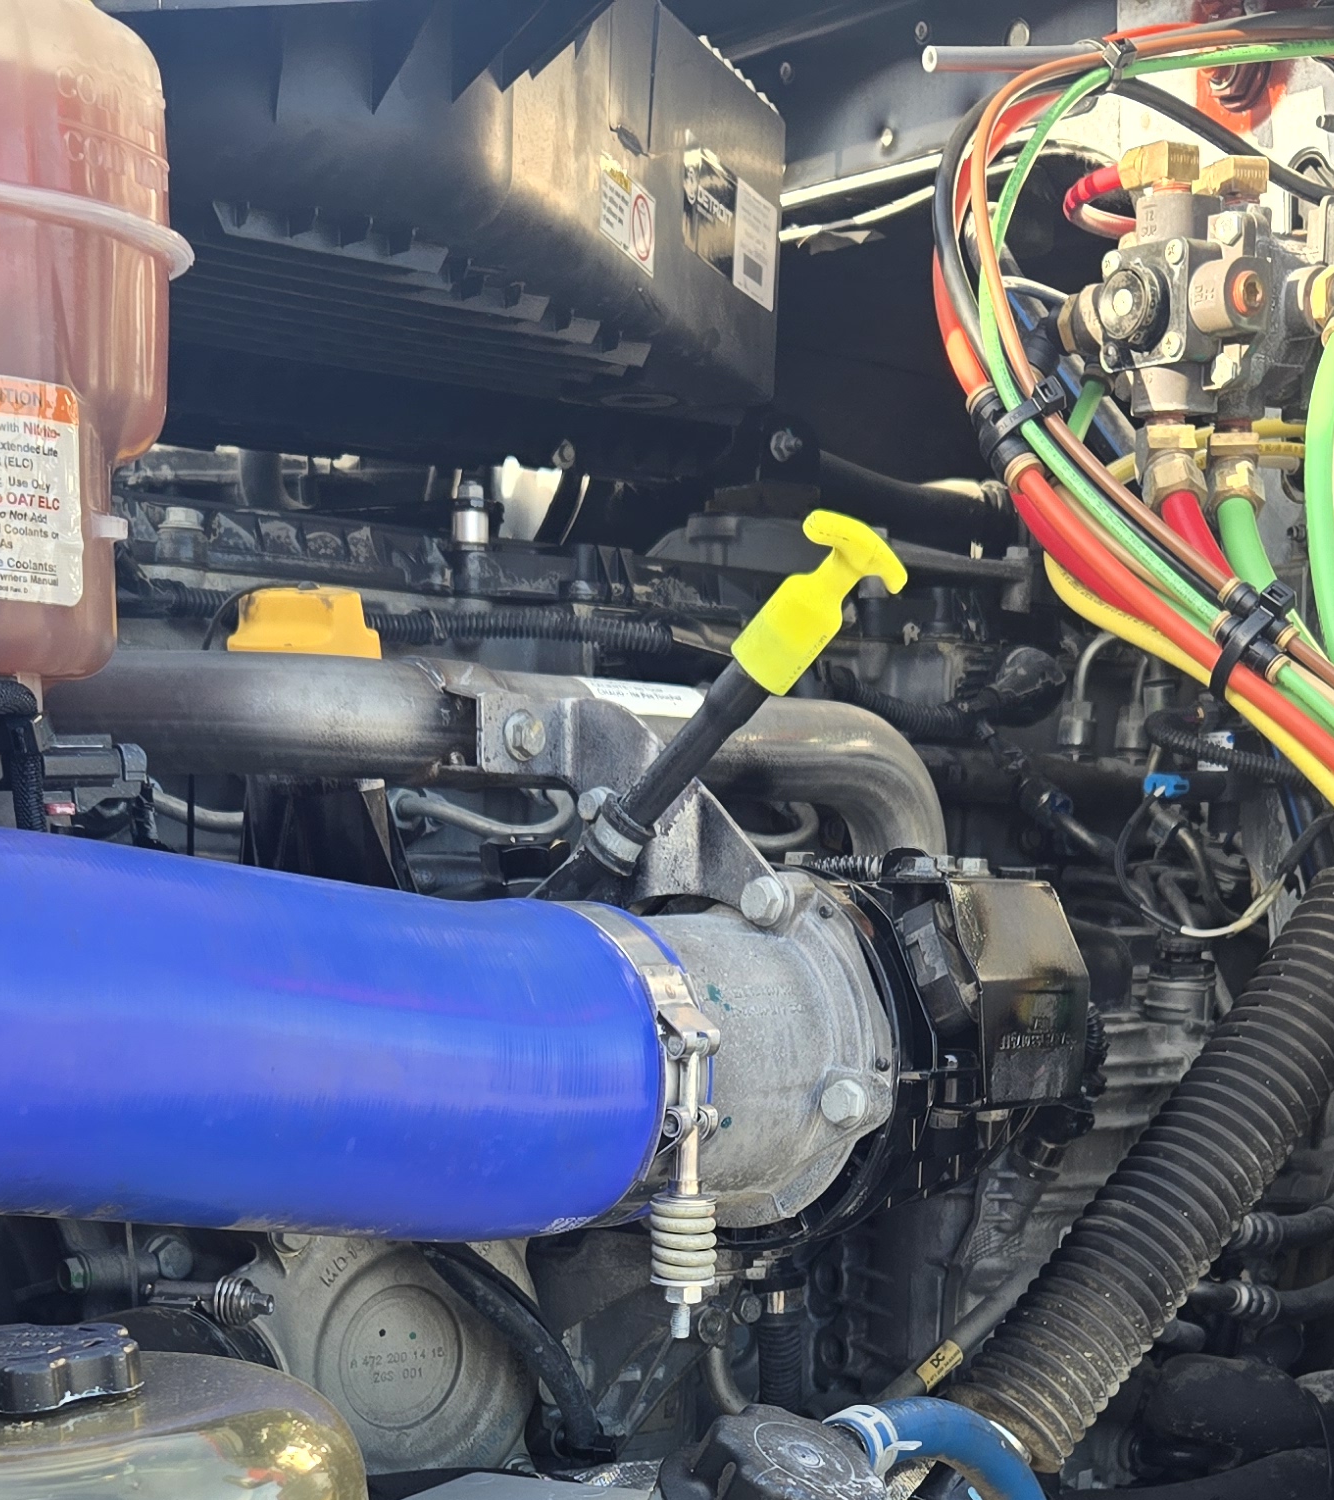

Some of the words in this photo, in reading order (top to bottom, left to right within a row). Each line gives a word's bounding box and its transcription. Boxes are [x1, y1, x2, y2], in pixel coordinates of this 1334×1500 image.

[697, 185, 733, 227] DETROIT
[4, 457, 34, 470] (ELC)
[8, 476, 28, 489] Use
[6, 492, 36, 507] OAT
[38, 496, 61, 511] ELC
[9, 510, 28, 521] Not
[30, 513, 48, 525] Add
[4, 524, 49, 539] Coolants
[7, 557, 57, 573] Coolants:
[30, 575, 58, 587] Manual
